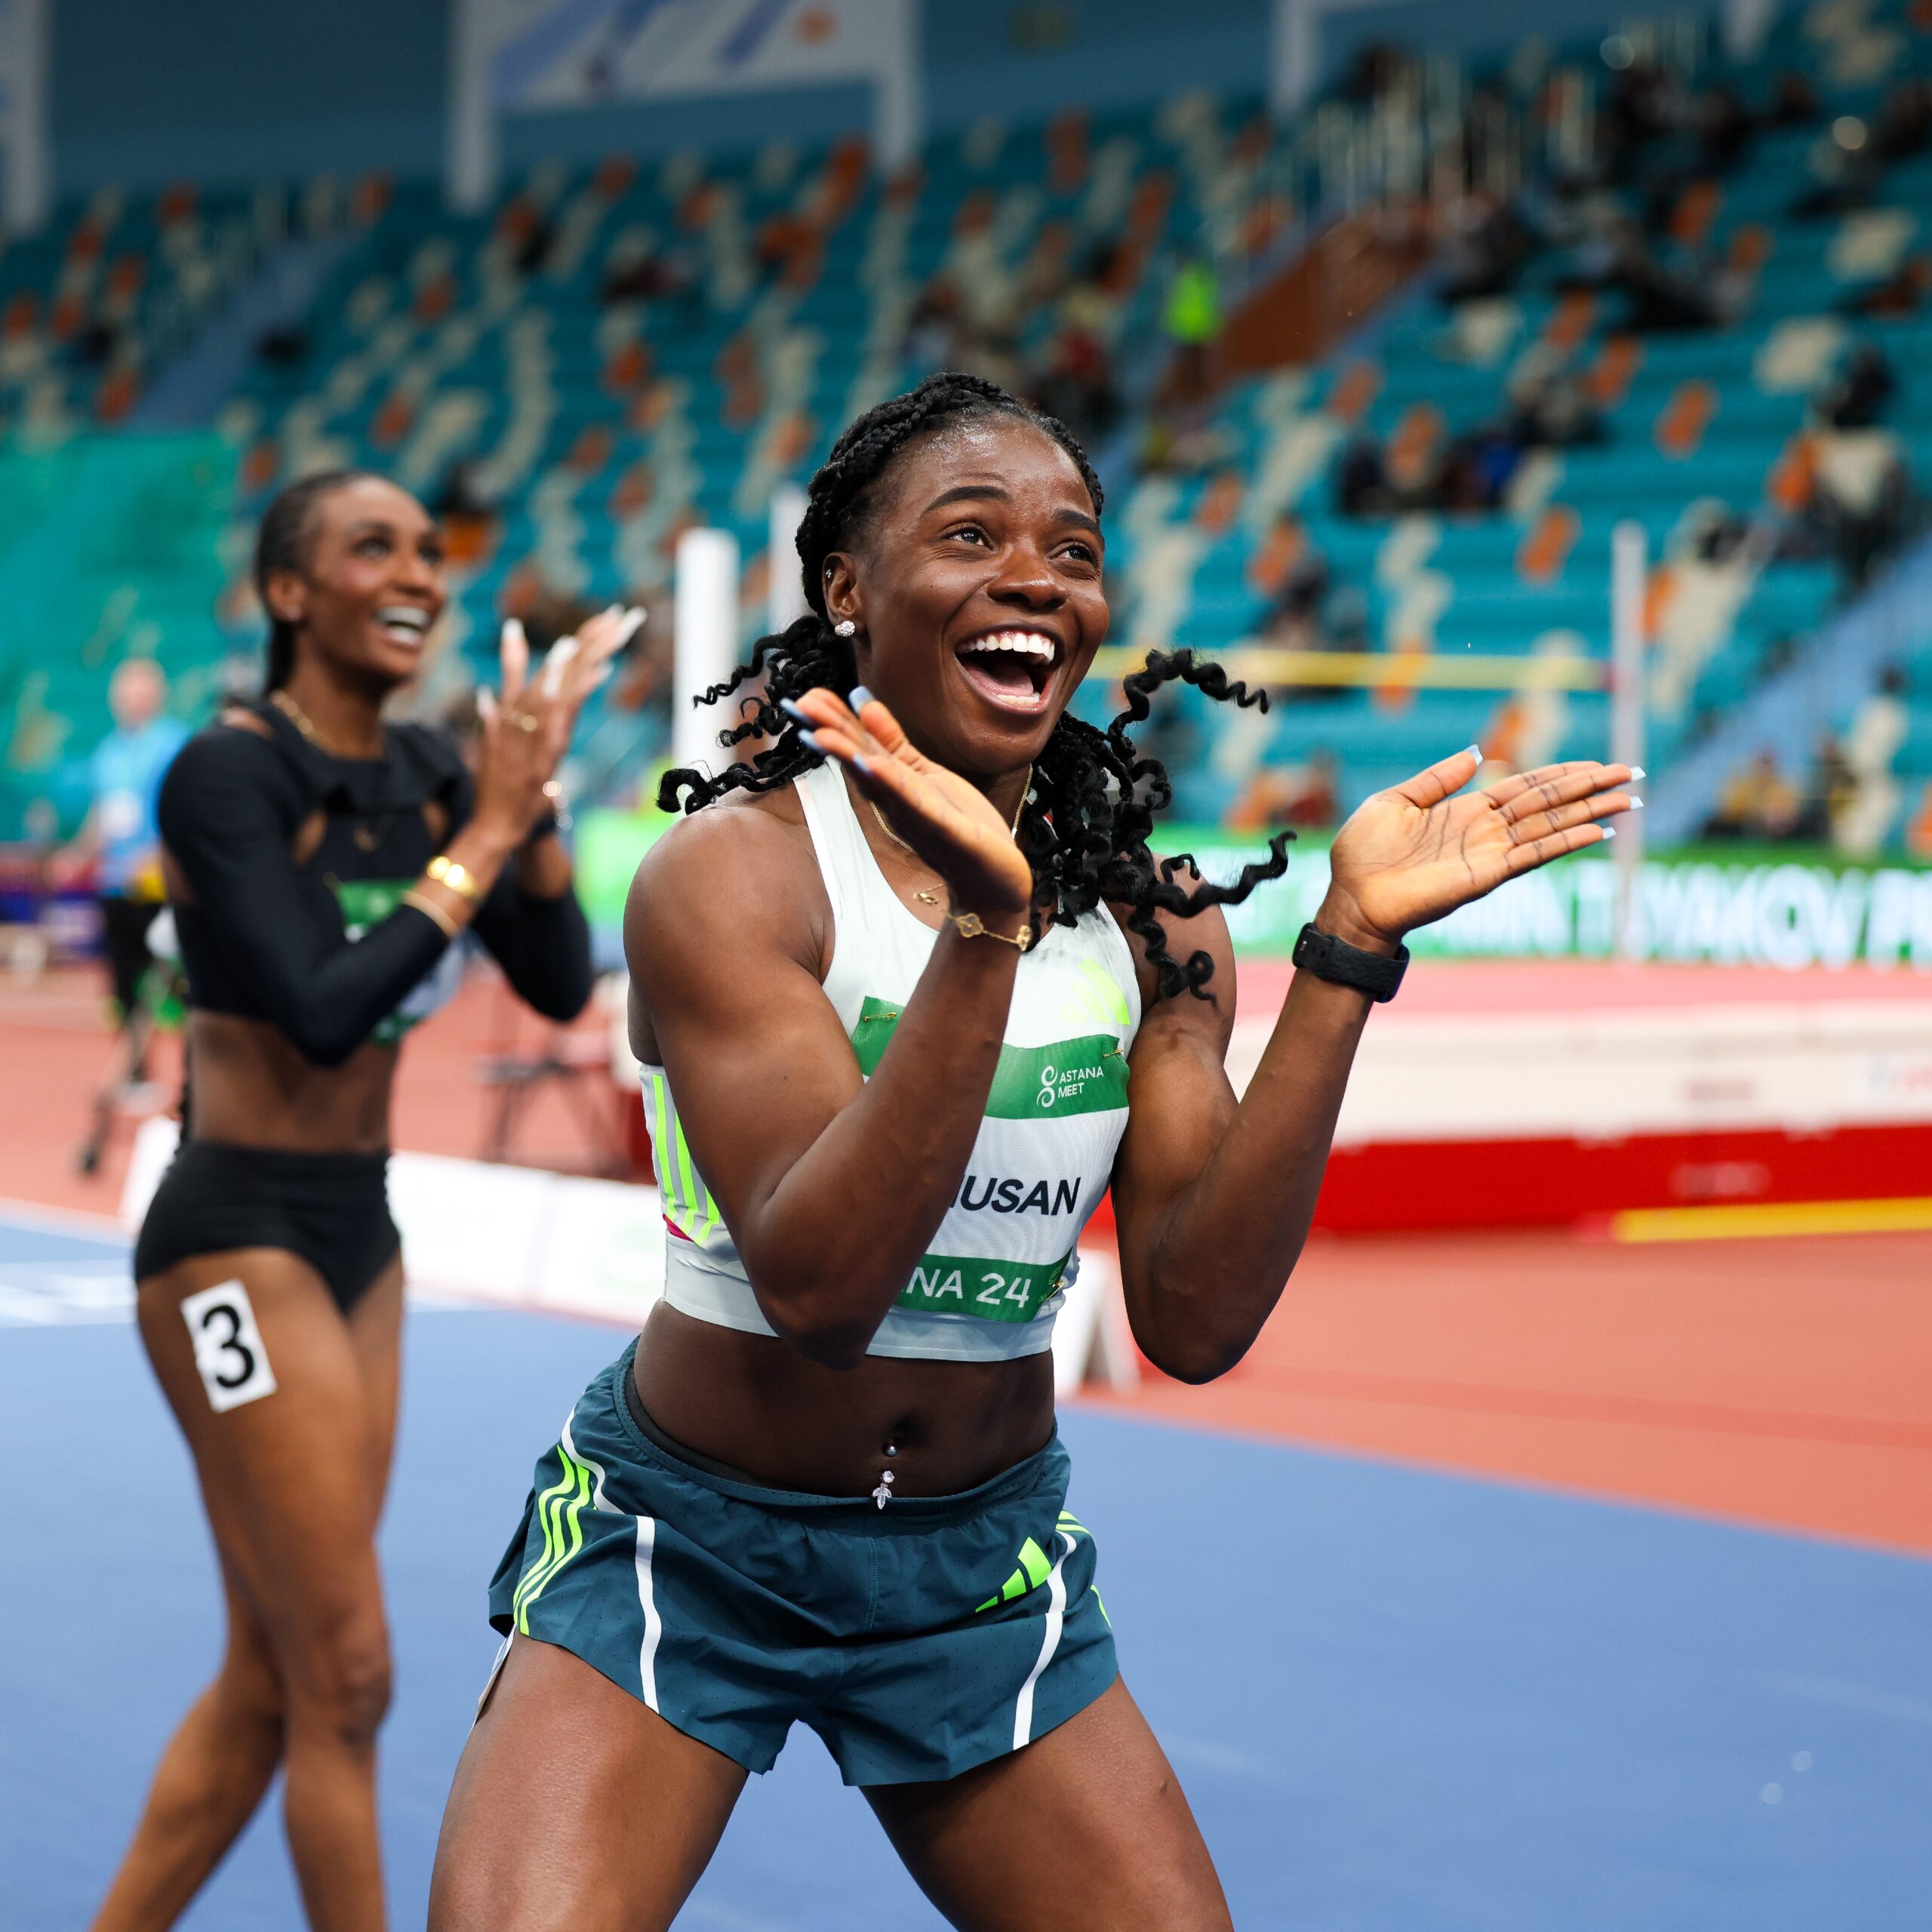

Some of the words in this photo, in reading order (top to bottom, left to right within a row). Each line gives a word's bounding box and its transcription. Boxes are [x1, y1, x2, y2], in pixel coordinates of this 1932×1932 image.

[1057, 1082, 1085, 1098] MEET
[1060, 1066, 1104, 1084] ASTANA
[949, 1175, 1081, 1216] USAN
[901, 1266, 964, 1300] NA
[976, 1272, 1032, 1309] 24
[202, 1305, 254, 1388] 3
